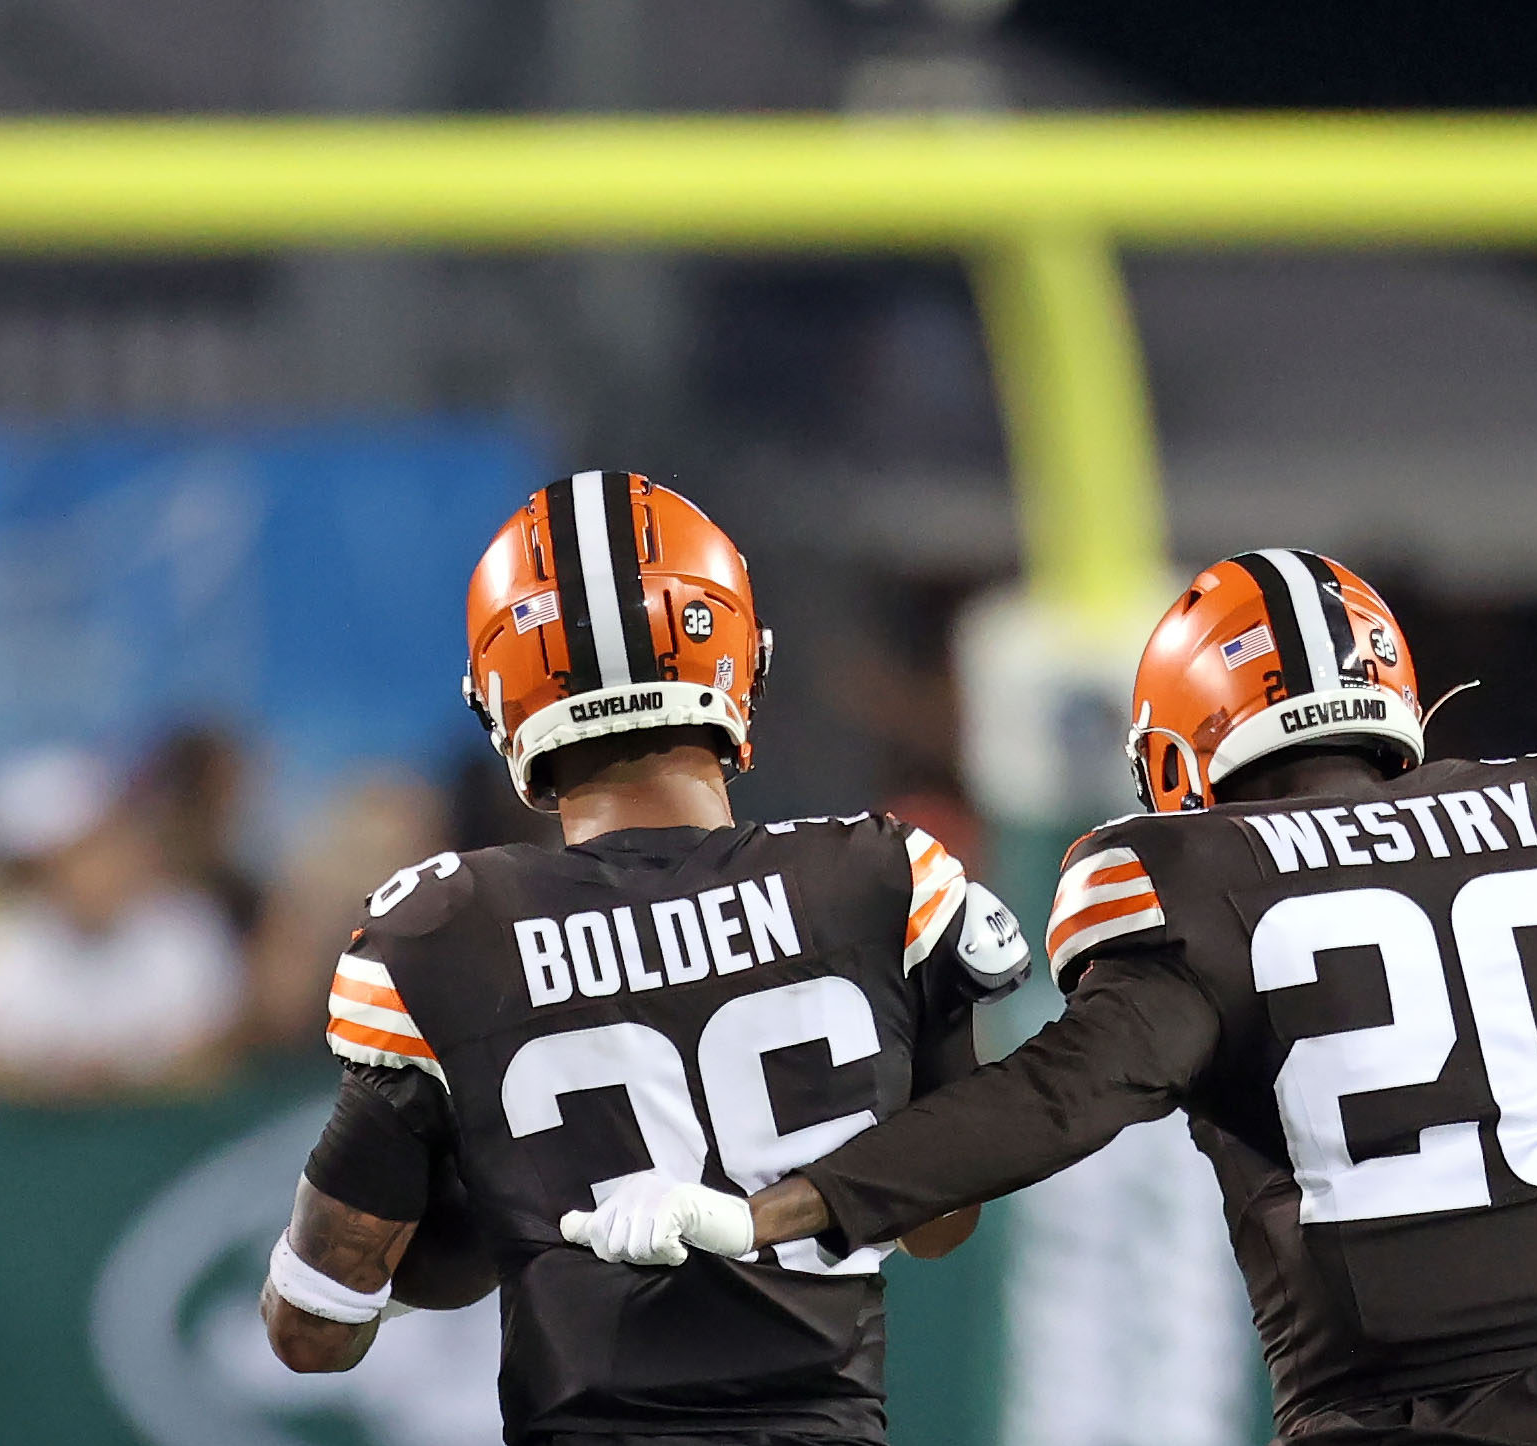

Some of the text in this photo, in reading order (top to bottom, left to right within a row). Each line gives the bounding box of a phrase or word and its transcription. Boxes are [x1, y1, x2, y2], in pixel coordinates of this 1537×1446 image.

[683, 608, 712, 636] 32
[1371, 632, 1397, 663] 32
[659, 653, 679, 681] 6
[1263, 670, 1288, 706] 2
[569, 691, 664, 723] CLEVELAND
[1280, 699, 1387, 734] CLEVELAND
[514, 873, 802, 1008] BOLDEN
